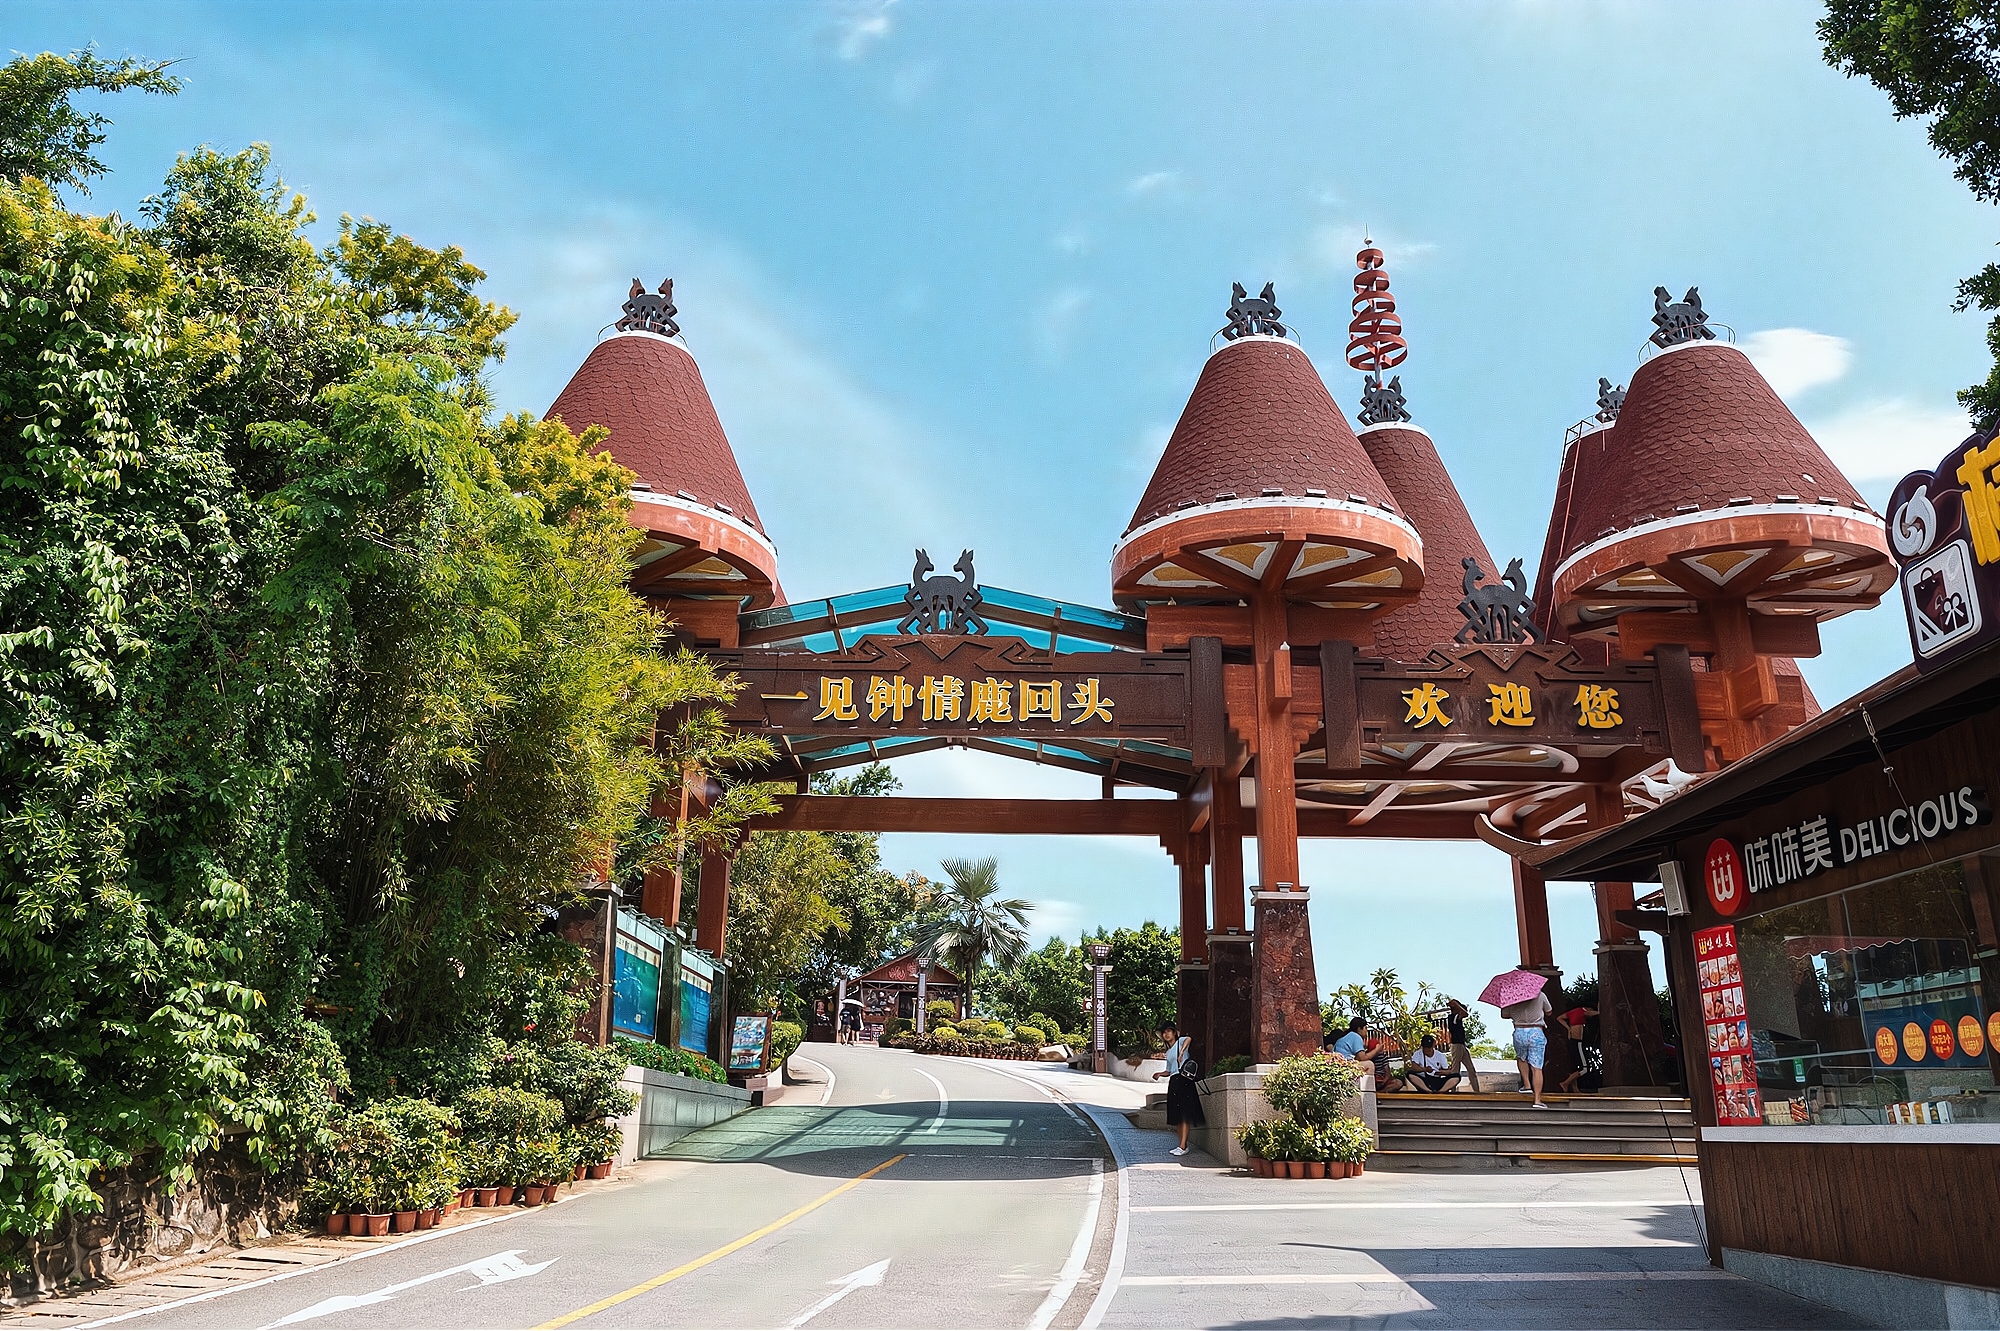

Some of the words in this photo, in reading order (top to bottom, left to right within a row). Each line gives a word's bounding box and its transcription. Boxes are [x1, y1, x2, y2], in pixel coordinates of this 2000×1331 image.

[760, 674, 1115, 724] 一见钟情鹿回头
[1401, 682, 1624, 729] 欢迎您
[1744, 814, 1833, 894] 味味美
[1839, 786, 1978, 863] DELICIOUS
